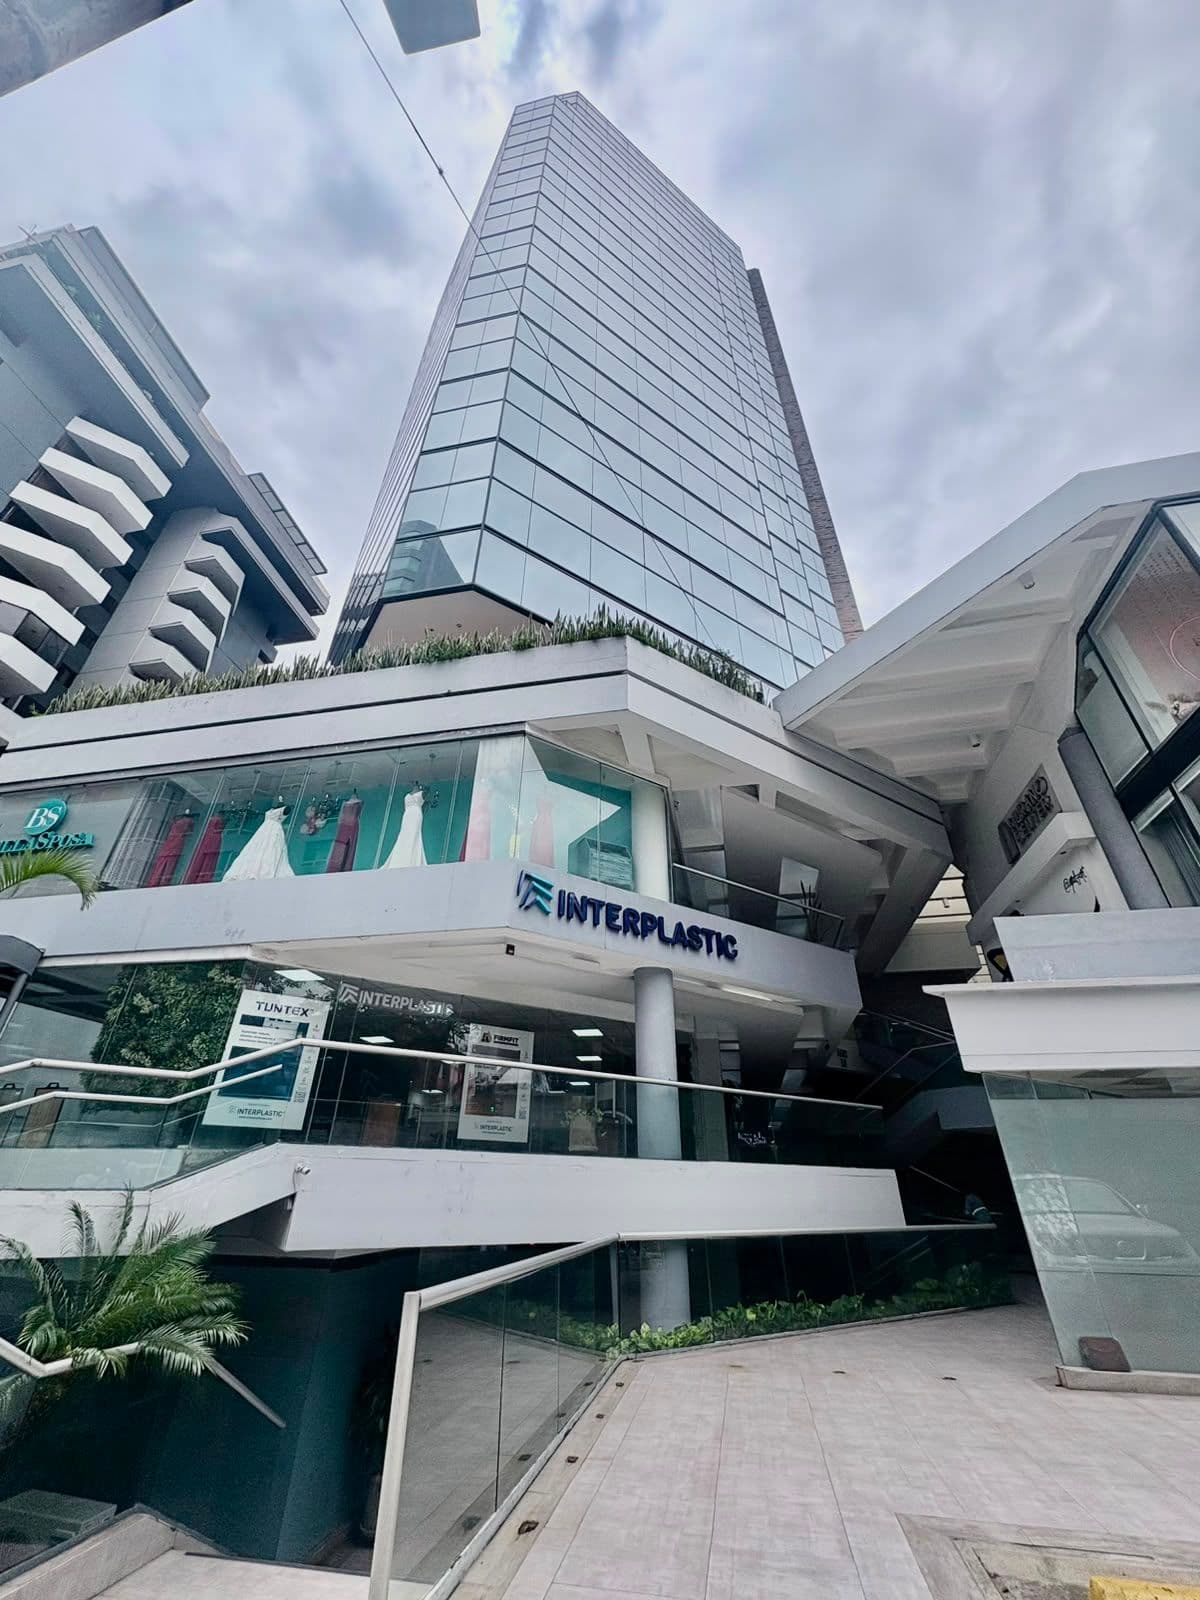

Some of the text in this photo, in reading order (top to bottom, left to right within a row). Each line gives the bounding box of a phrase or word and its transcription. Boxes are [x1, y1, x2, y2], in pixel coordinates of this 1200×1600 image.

[24, 806, 62, 829] BS
[557, 889, 738, 961] INTERPLASTIC
[256, 1001, 310, 1017] TUNTEX
[237, 1108, 283, 1117] INTERPLASTIC
